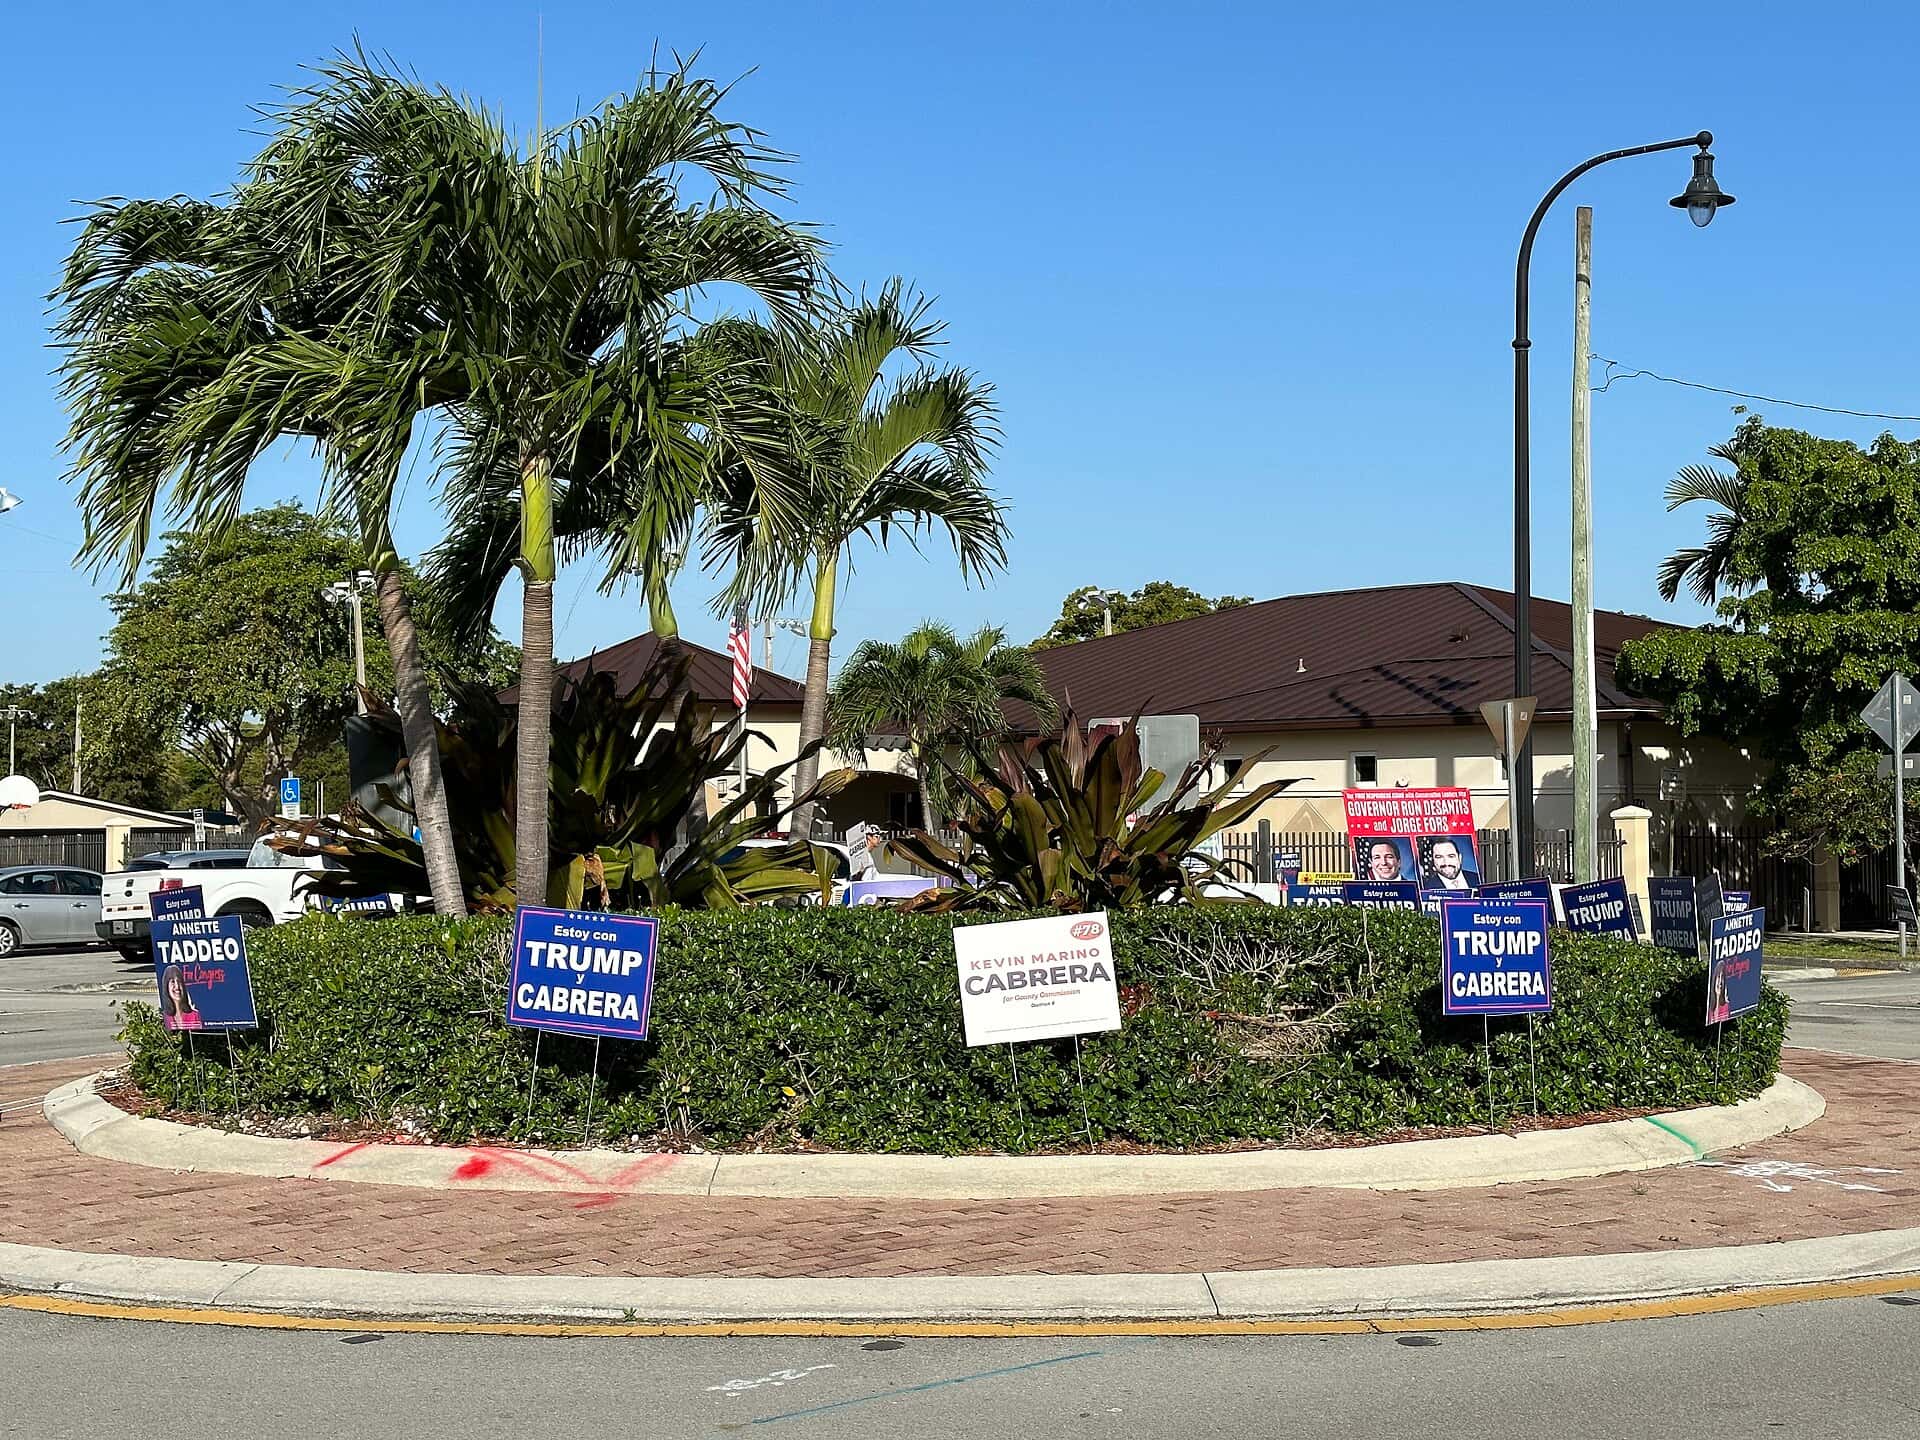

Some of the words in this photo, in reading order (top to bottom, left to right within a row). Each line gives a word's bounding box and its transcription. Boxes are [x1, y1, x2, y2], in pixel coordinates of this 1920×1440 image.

[1347, 800, 1400, 817] GOVERNOR
[1402, 800, 1422, 816] RON
[1424, 798, 1470, 815] DESANTIS
[1373, 820, 1387, 831] and
[1390, 817, 1423, 833] JORGE
[1424, 816, 1449, 832] FORS
[1274, 859, 1301, 869] TADDE
[1308, 886, 1344, 895] ANNET
[1363, 890, 1381, 898] Estoy
[1578, 894, 1596, 903] Estoy
[1596, 891, 1609, 900] con
[166, 899, 180, 909] Estoy
[180, 898, 191, 906] con
[1293, 898, 1345, 908] TADD
[1653, 900, 1693, 919] TRUMP
[1724, 902, 1747, 912] TRUMP
[1473, 913, 1502, 927] Estoy
[1503, 915, 1521, 924] con
[1568, 900, 1624, 926] TRUMP
[172, 921, 220, 936] ANNETTE
[1072, 924, 1101, 937] #78
[1724, 914, 1754, 932] ANNETTE
[554, 925, 590, 942] Estoy
[592, 931, 617, 942] con
[1655, 929, 1696, 949] CABRERA
[157, 937, 240, 964] TADDEO
[1452, 931, 1541, 956] TRUMP
[1714, 928, 1761, 960] TADDEO
[525, 940, 643, 976] TRUMP
[970, 955, 1025, 971] KEVIN
[1031, 947, 1101, 964] MARINO
[1495, 956, 1503, 968] y
[183, 964, 194, 982] For
[194, 963, 225, 990] Congress
[576, 973, 585, 985] y
[965, 962, 1111, 996] CABRERA
[1452, 971, 1546, 997] CABRERA
[517, 983, 640, 1021] CABRERA
[1002, 995, 1014, 1004] for
[1014, 993, 1038, 1001] County
